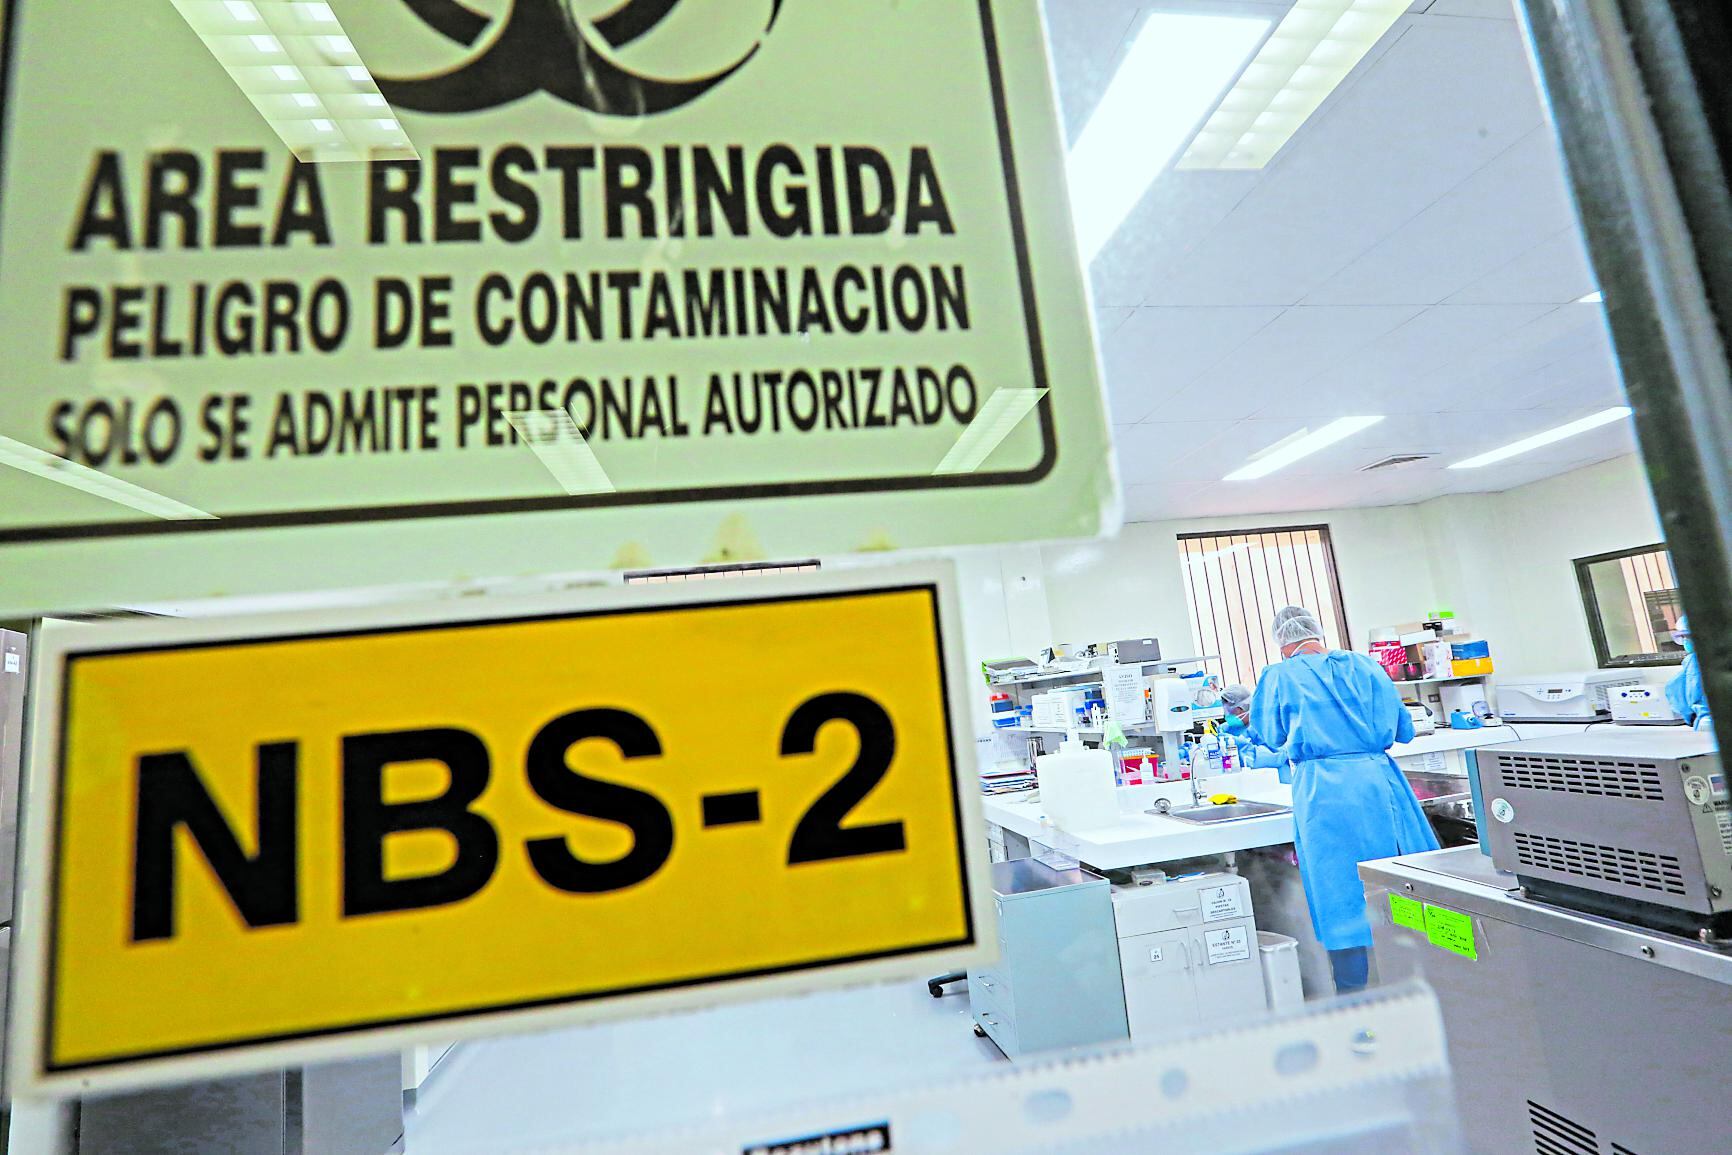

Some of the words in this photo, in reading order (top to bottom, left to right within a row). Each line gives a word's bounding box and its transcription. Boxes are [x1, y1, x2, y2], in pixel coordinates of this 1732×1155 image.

[68, 148, 333, 251] AREA
[367, 143, 956, 244] RESTRINGIDA
[59, 277, 350, 361] PELIGRO
[373, 275, 454, 349] DE
[475, 264, 971, 346] CONTAMINACION
[48, 395, 182, 467] SOLO
[199, 394, 250, 461] SE
[266, 384, 440, 458] ADMITE
[457, 374, 689, 446] PERSONAL
[703, 364, 978, 435] AUTORIZADO
[128, 691, 907, 945] NBS-2
